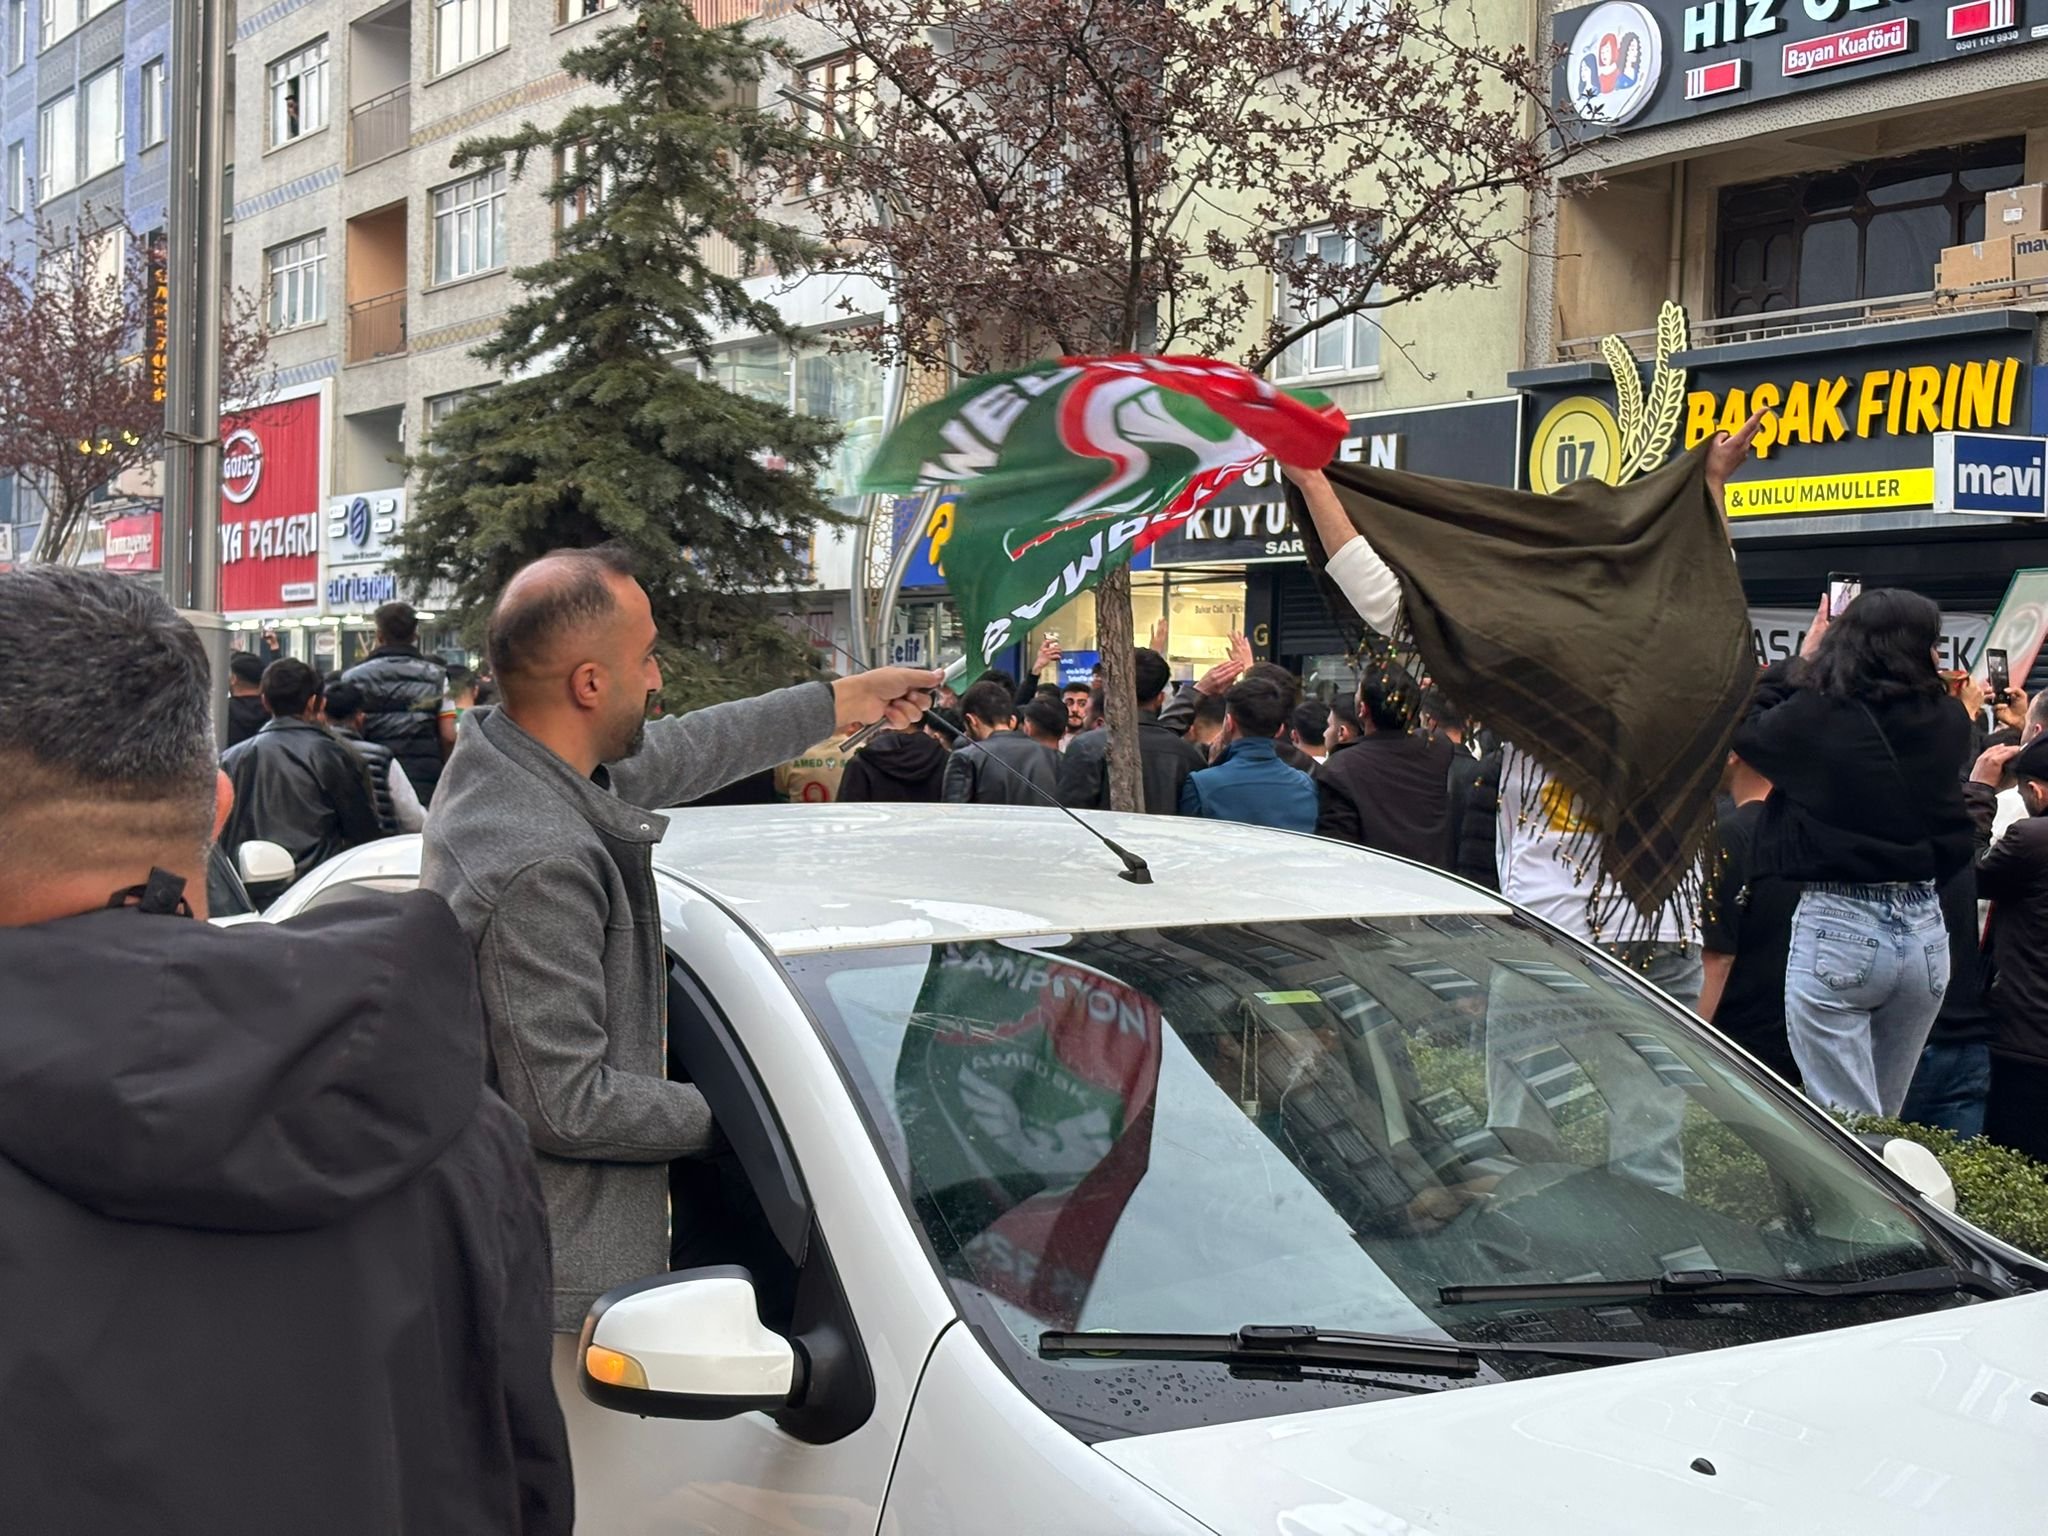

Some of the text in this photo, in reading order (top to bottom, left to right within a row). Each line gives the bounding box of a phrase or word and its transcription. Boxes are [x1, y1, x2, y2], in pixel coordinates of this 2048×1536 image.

[1788, 25, 1902, 70] Bayan Kuaförü
[1980, 36, 1995, 46] 174
[1685, 356, 2022, 459] BAŞAK FIRINI
[1556, 435, 1595, 485] ÖZ
[1958, 456, 2041, 498] mavi
[1731, 480, 1900, 507] & UNLU MAMULLER
[221, 512, 318, 565] YA PAZARI
[1185, 502, 1299, 541] KUYU
[1265, 539, 1304, 554] SAR
[794, 757, 823, 770] AMED
